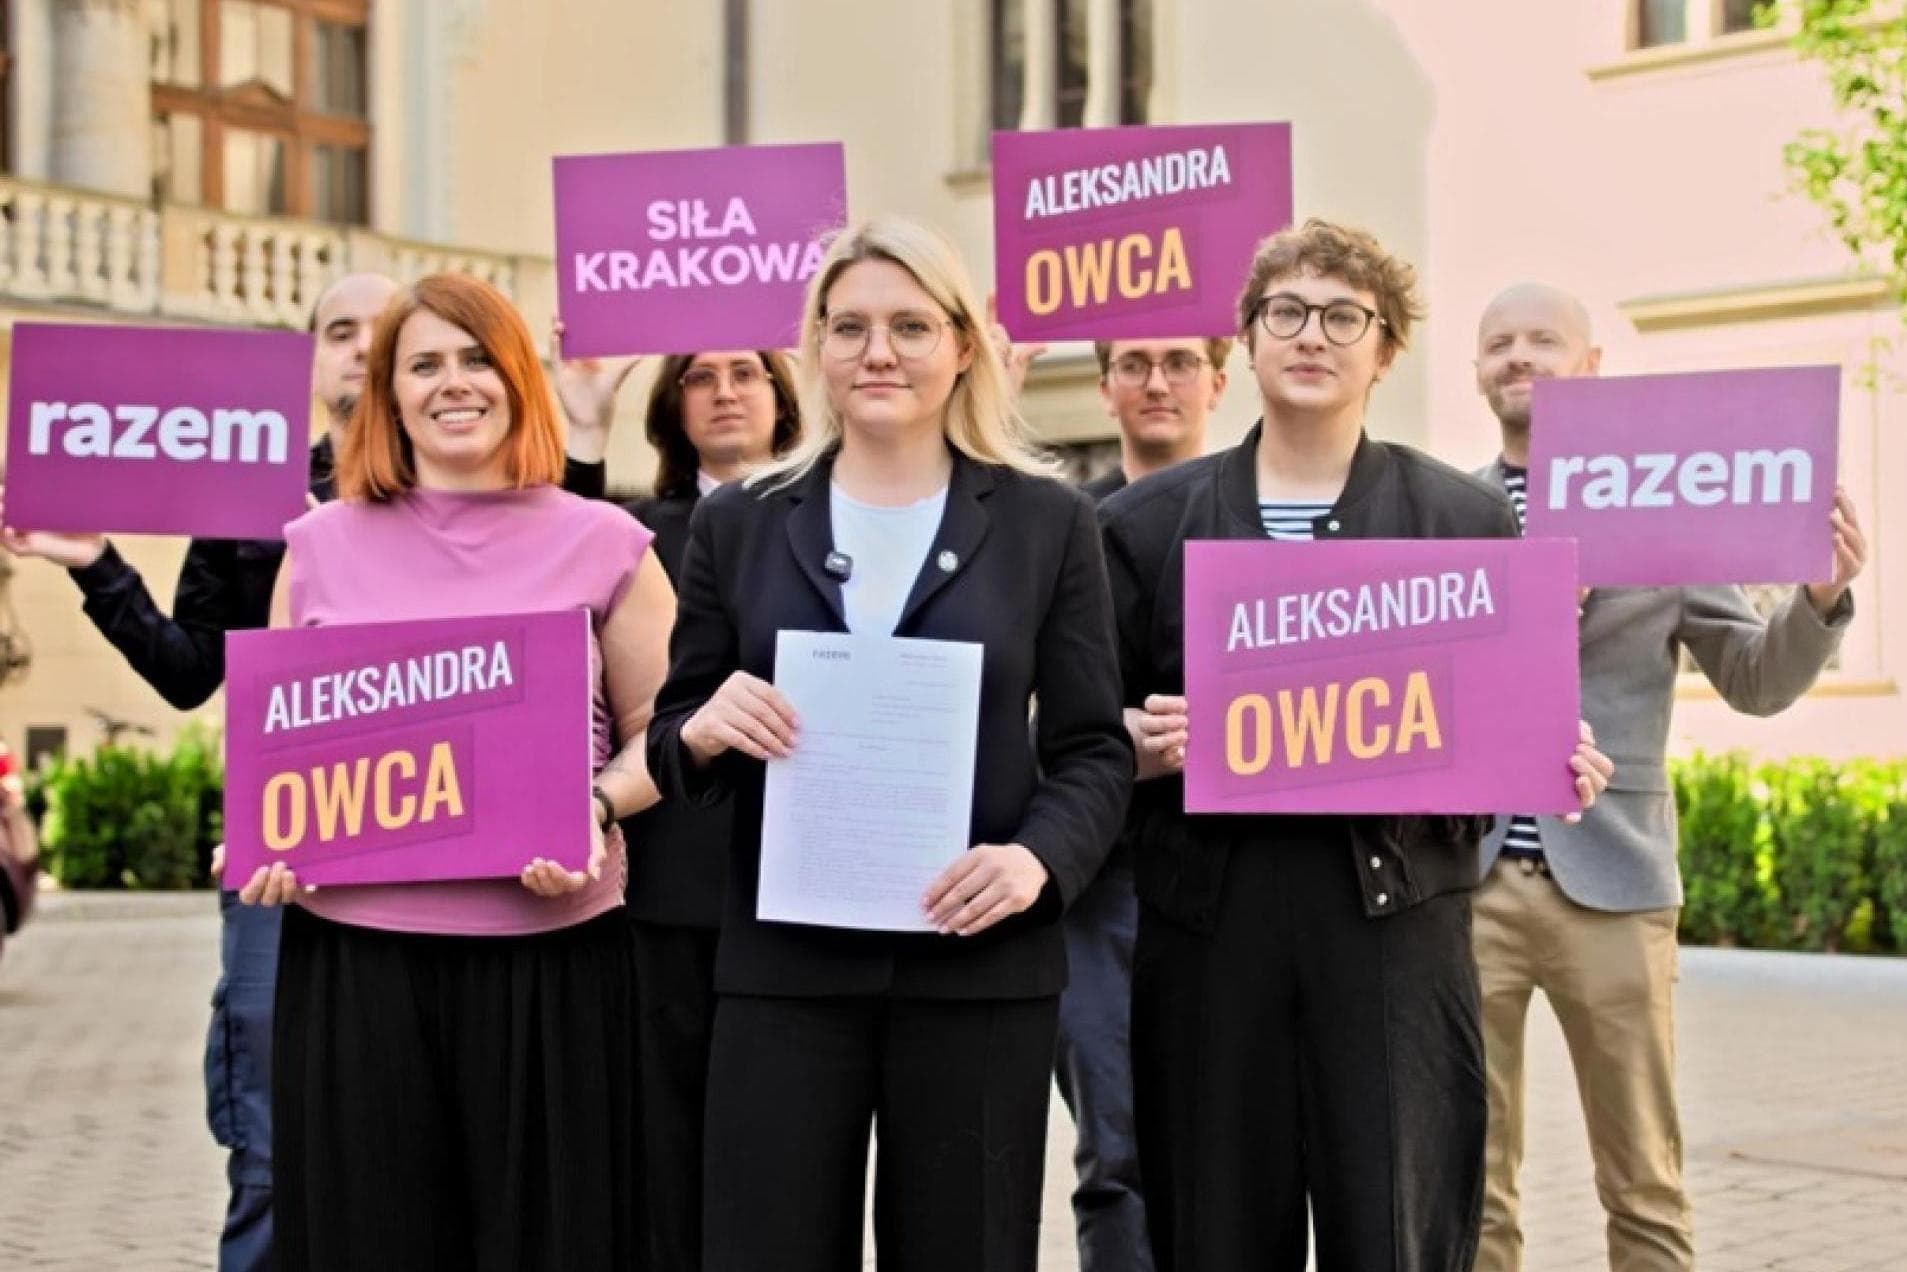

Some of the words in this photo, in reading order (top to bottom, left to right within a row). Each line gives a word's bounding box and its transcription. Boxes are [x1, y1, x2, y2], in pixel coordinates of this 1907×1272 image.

[646, 197, 757, 241] SIŁA
[1024, 144, 1232, 220] ALEKSANDRA
[574, 241, 825, 293] KRAKOWA
[1025, 228, 1193, 315] OWCA
[28, 402, 289, 465] razem
[1548, 448, 1813, 511] razem
[1225, 565, 1496, 655] ALEKSANDRA
[263, 641, 513, 734] ALEKSANDRA
[1225, 670, 1443, 776] OWCA
[262, 740, 464, 851] OWCA
